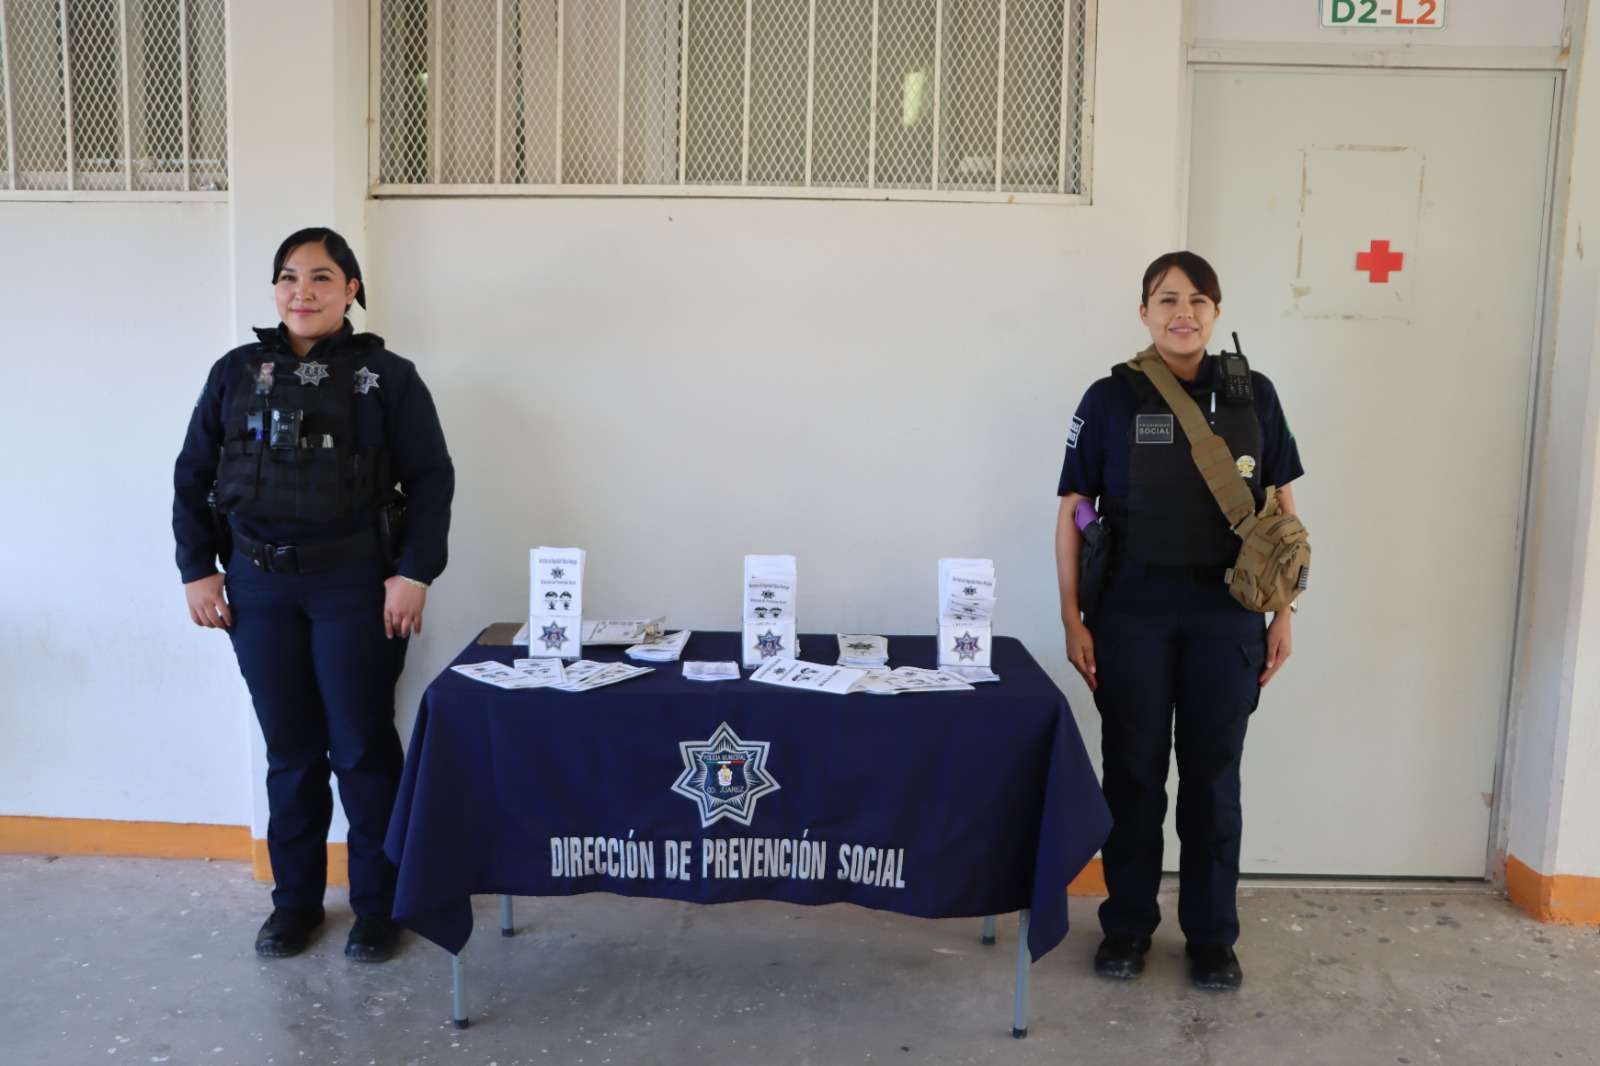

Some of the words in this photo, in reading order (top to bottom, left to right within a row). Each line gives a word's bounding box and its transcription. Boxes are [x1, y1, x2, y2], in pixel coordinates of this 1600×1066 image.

[1331, 0, 1437, 25] D2-L2
[1139, 427, 1170, 435] SOCIAL
[549, 829, 655, 880] DIRECCIÓN
[665, 839, 691, 881] DE
[702, 828, 827, 881] PREVENCIÓN
[836, 843, 906, 889] SOCIAL
